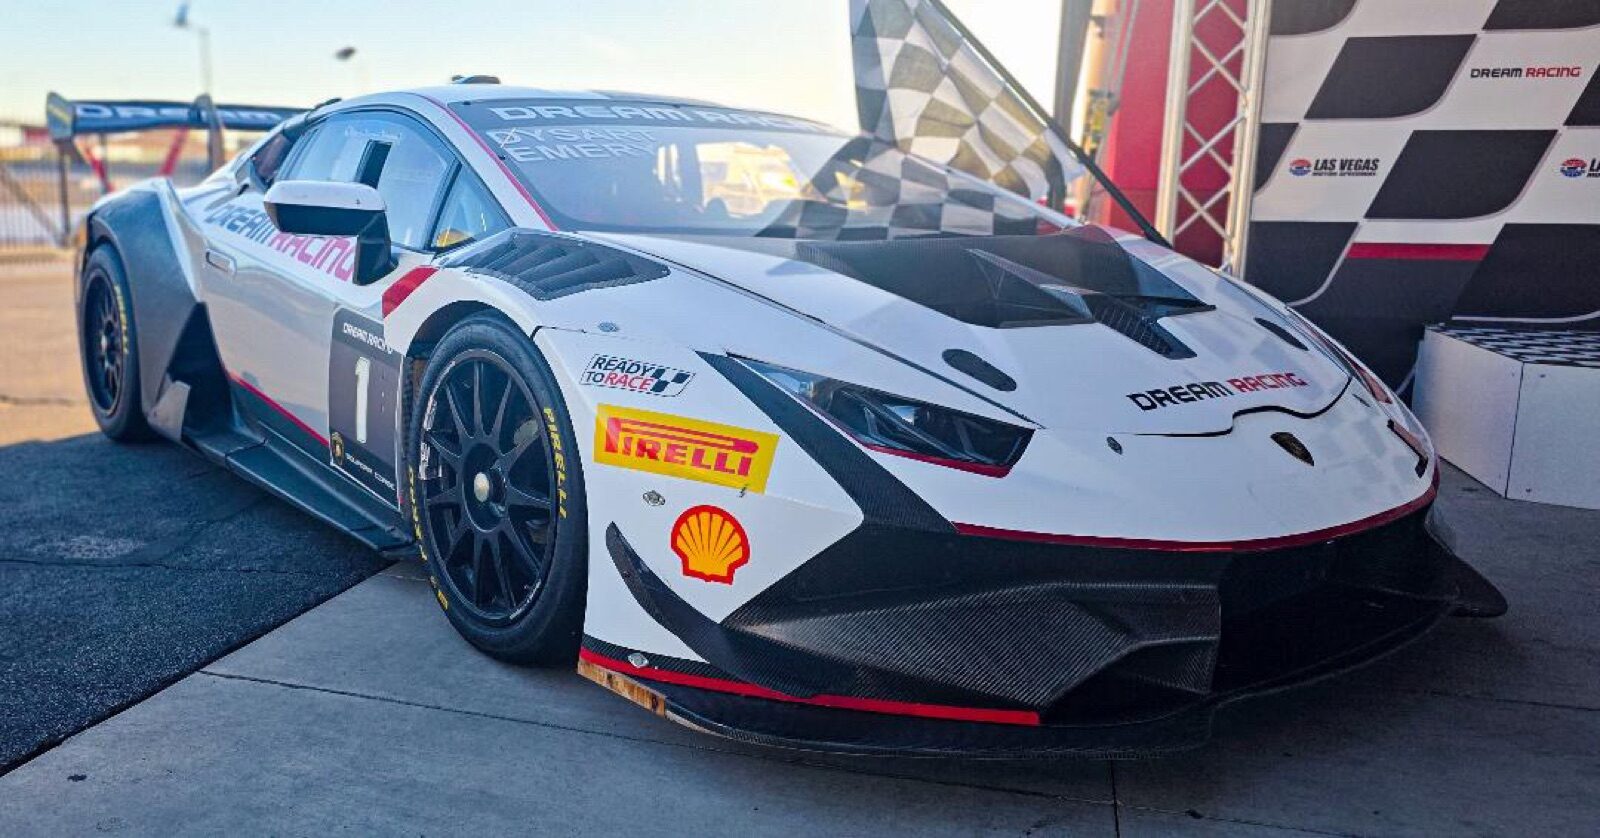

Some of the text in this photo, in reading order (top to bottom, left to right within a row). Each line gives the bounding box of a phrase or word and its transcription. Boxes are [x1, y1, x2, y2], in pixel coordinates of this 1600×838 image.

[1470, 66, 1581, 78] DREAM RACING
[489, 104, 695, 121] DREAM
[1313, 158, 1379, 170] LAS VEGAS
[592, 356, 656, 376] READY
[586, 371, 654, 391] TO RACE
[355, 356, 370, 444] 1
[1126, 372, 1309, 411] DREAM RACING
[604, 416, 760, 477] PIRELLI
[543, 407, 567, 519] PIRELLI
